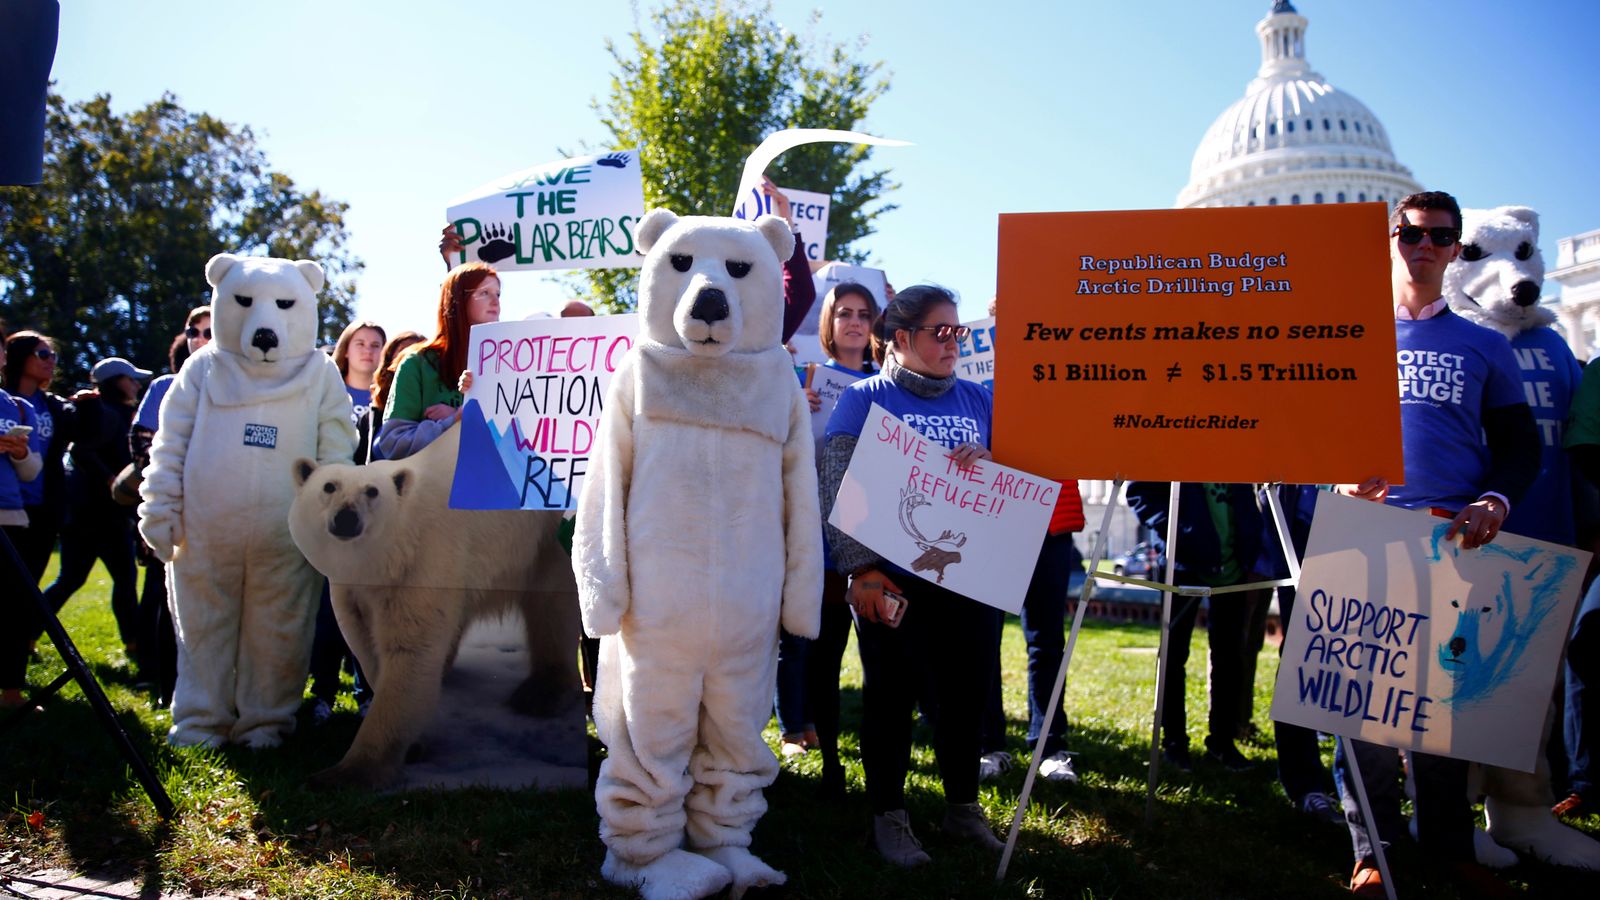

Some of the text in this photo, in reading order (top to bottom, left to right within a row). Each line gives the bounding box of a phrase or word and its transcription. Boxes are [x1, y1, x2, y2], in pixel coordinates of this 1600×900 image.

[505, 189, 578, 219] THE
[1079, 252, 1288, 274] Republican Budget
[1075, 276, 1292, 297] Arctic Drilling Plan
[1024, 321, 1365, 341] Few cents makes no sense
[478, 335, 606, 376] PROTECT
[1033, 363, 1057, 384] $1
[1065, 363, 1147, 381] Billion
[1202, 363, 1253, 383] $1.5
[1258, 363, 1357, 381] Trillion
[246, 425, 276, 434] PROTECT
[902, 413, 978, 431] PROTECT
[1113, 415, 1259, 431] #NoArcticRider
[876, 415, 928, 463] SAVE
[991, 471, 1053, 506] ARCTIC
[907, 465, 1005, 519] REFUGE!!
[1306, 588, 1429, 646] SUPPORT
[1304, 634, 1408, 678] ARCTIC
[1298, 666, 1433, 732] WILDLIFE
